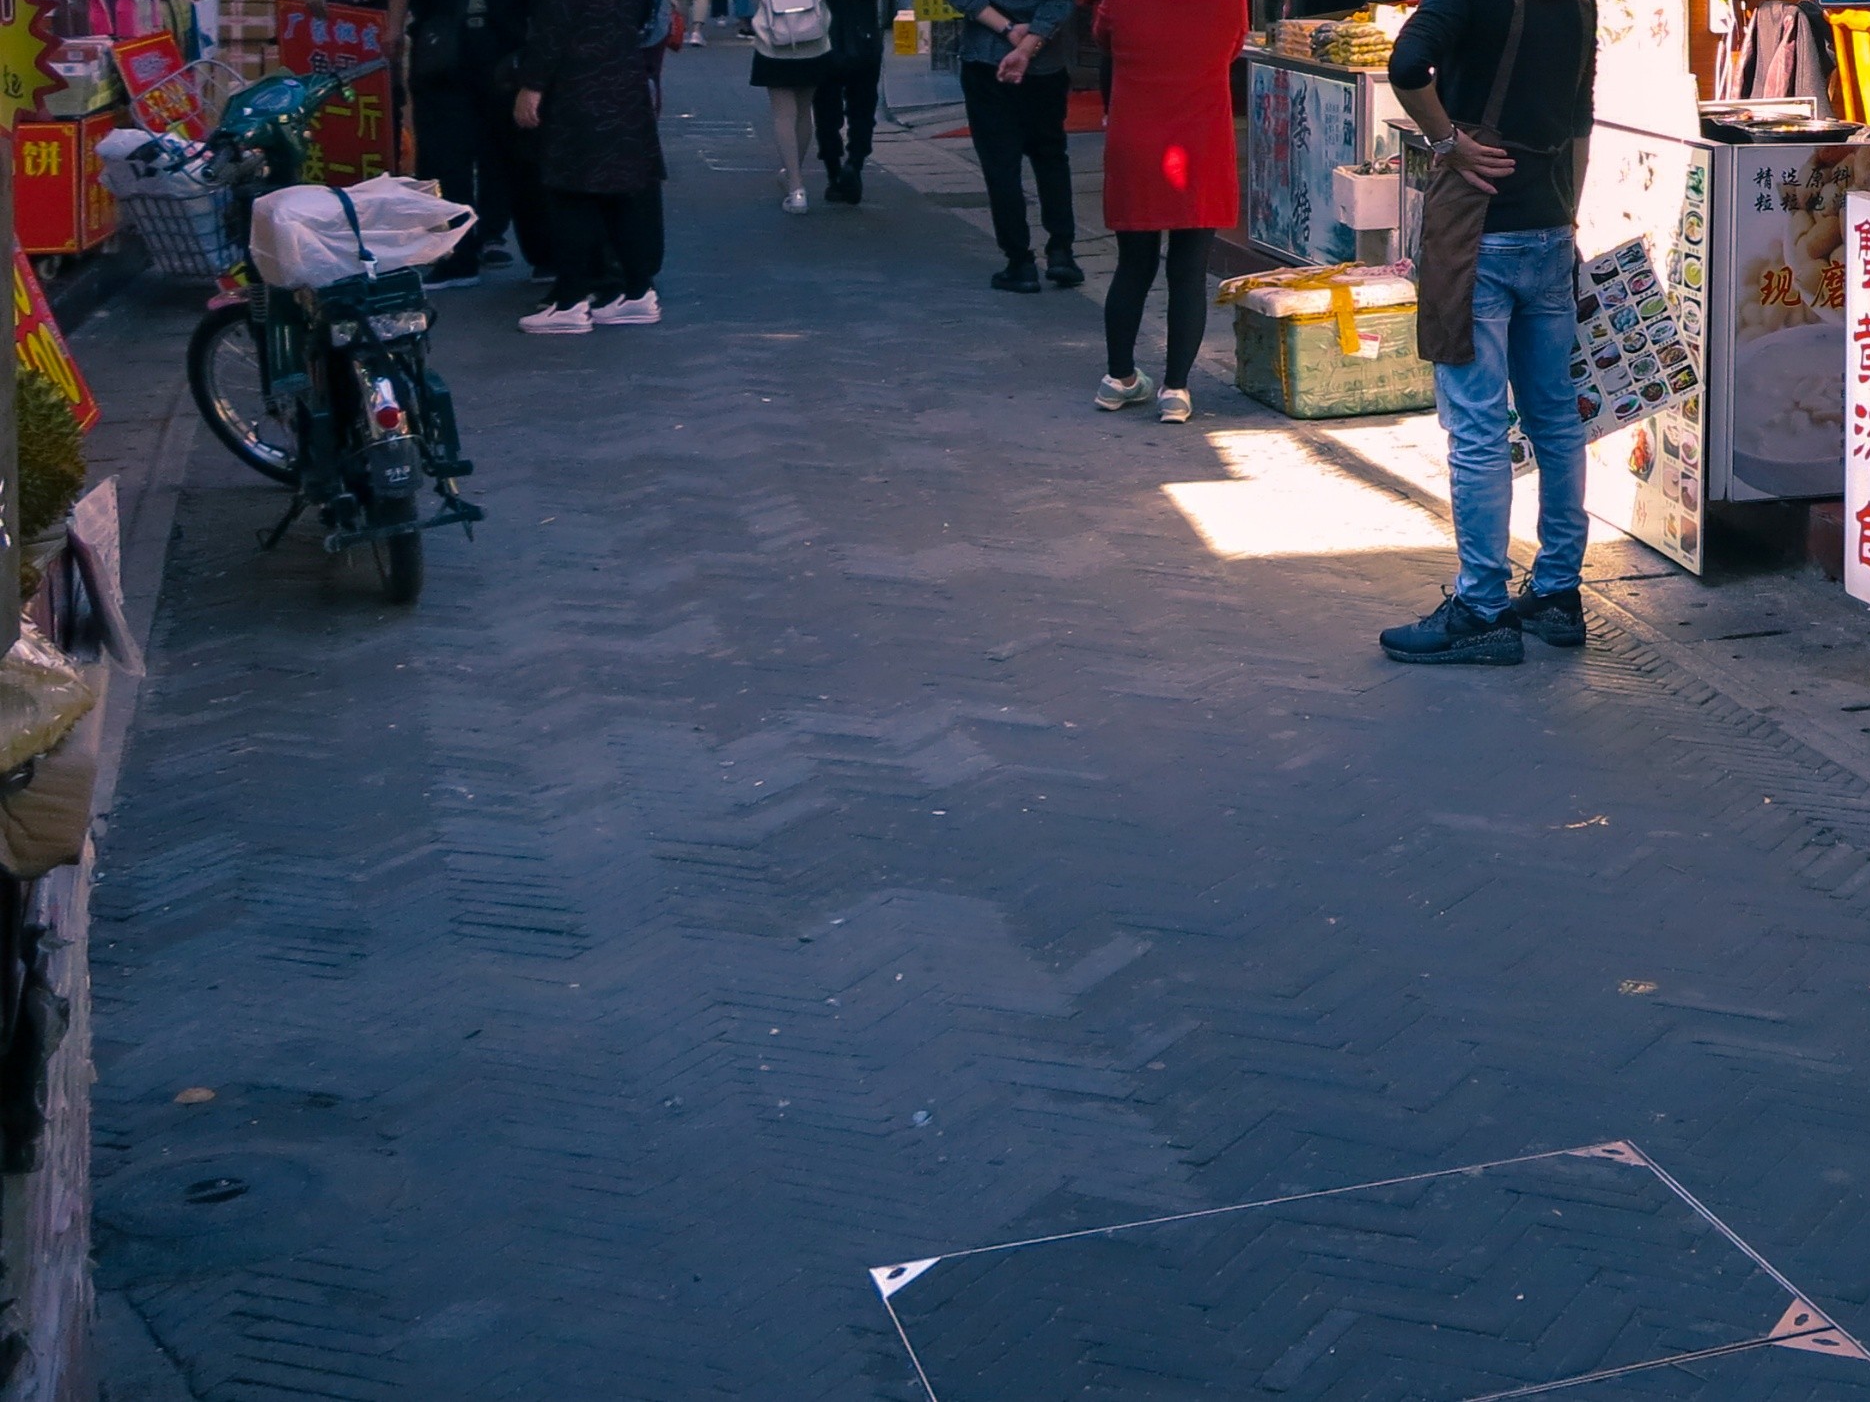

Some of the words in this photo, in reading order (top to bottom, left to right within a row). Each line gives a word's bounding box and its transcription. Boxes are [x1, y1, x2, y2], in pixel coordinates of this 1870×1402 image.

[308, 95, 384, 141] 一斤
[21, 140, 61, 177] 饼
[1753, 166, 1851, 191] 精选原料
[1760, 259, 1845, 311] 现磨
